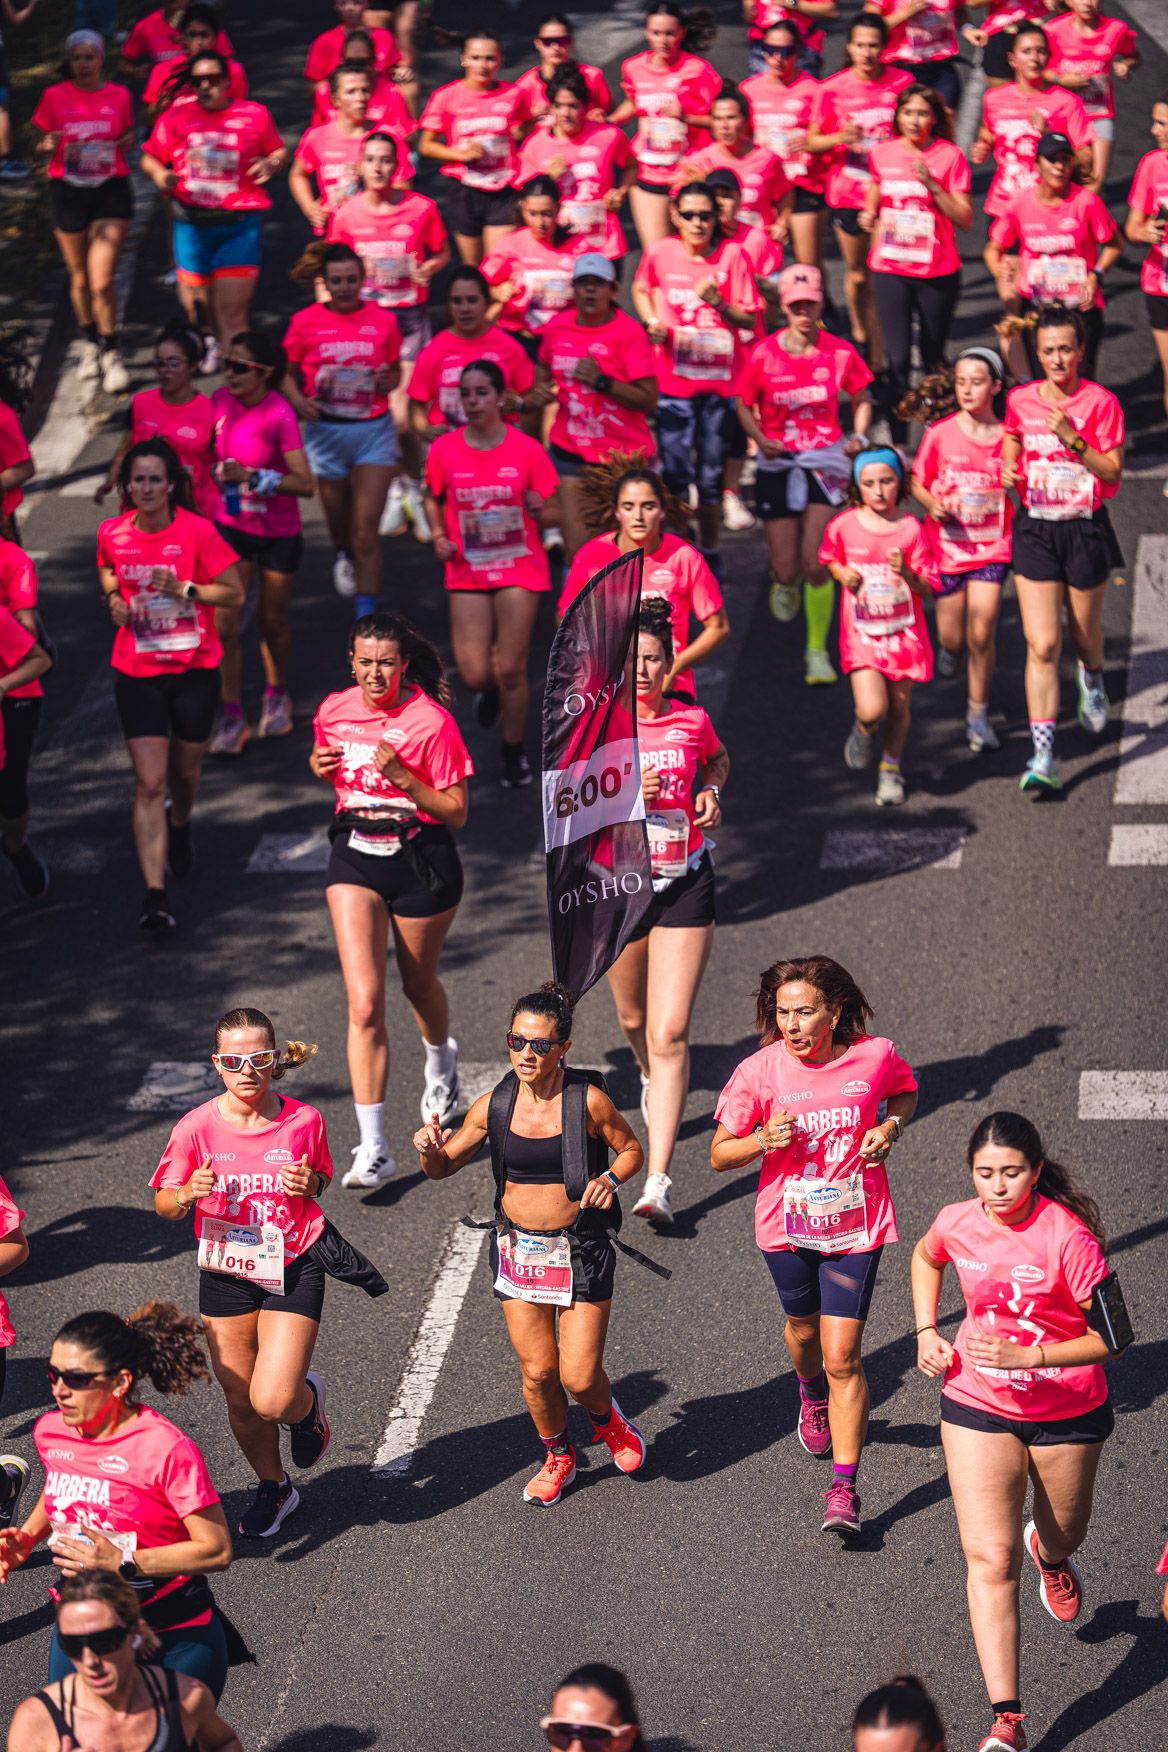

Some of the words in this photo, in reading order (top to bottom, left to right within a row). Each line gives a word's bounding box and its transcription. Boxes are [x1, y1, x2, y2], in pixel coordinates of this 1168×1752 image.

[649, 841, 668, 854] 16
[558, 872, 643, 915] OYSHO
[778, 1090, 813, 1104] OYSHO
[796, 1105, 861, 1133] ARRERA
[808, 1192, 840, 1202] ASTURIANA
[810, 1213, 841, 1228] 016
[228, 1233, 257, 1245] ASTURIANA
[225, 1256, 256, 1271] 016
[515, 1264, 546, 1277] 016
[957, 1257, 987, 1273] OYSHO
[1011, 1369, 1023, 1381] DE
